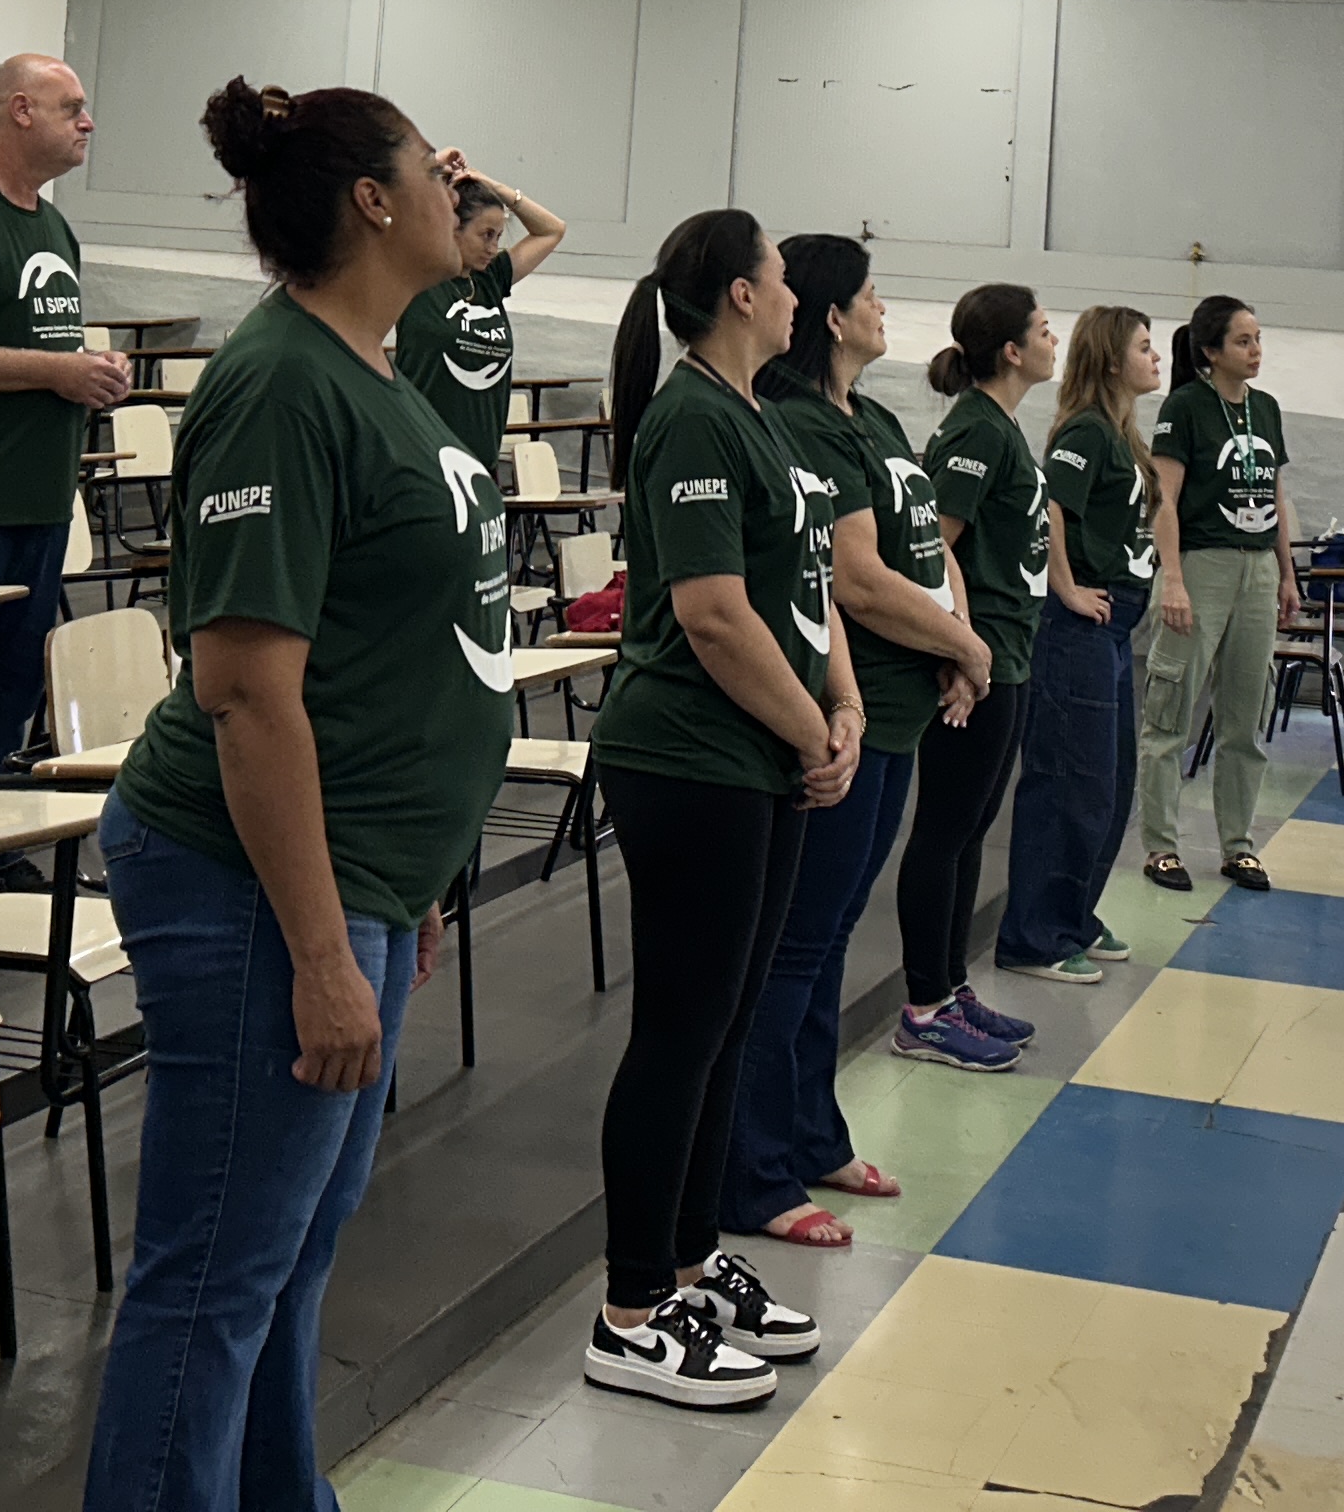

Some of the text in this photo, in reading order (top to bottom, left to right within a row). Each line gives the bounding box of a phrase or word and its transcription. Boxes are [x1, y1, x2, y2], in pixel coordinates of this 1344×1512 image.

[46, 297, 80, 314] SIPAT
[684, 478, 728, 495] UNEPE
[215, 485, 272, 514] UNEPE
